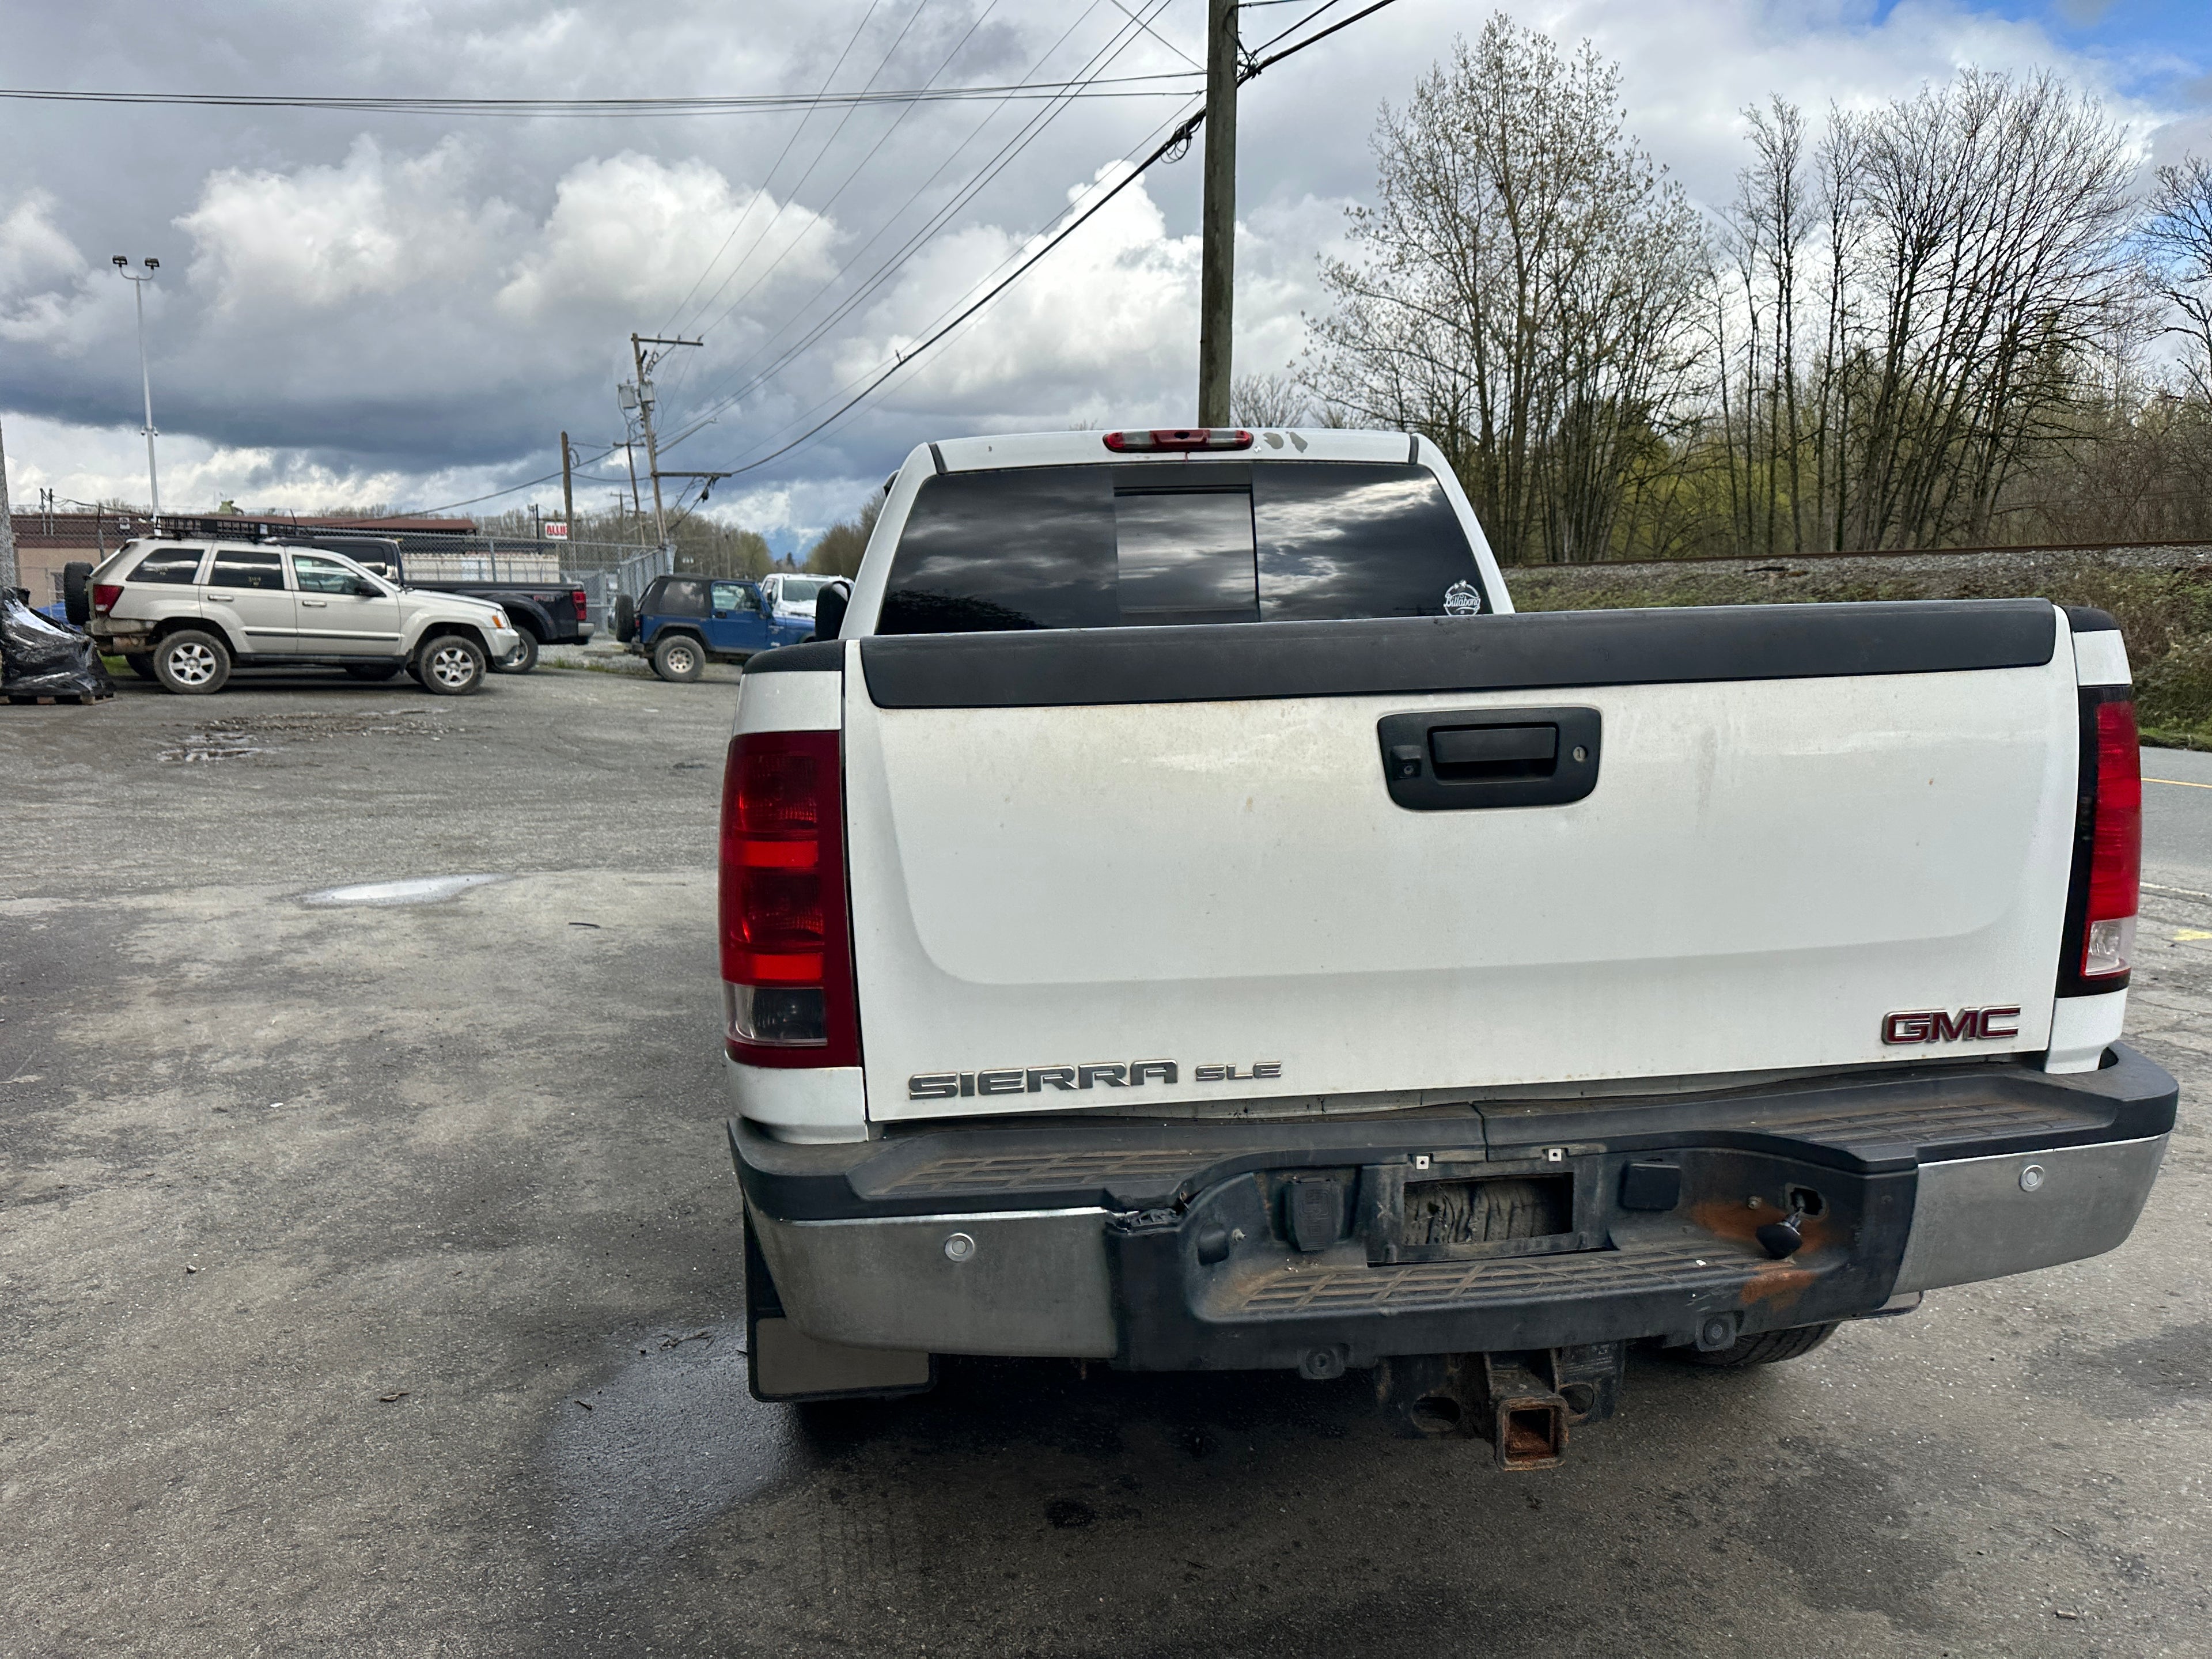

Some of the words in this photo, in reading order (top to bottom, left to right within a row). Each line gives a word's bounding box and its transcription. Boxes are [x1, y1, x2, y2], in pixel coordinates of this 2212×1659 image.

[1444, 594, 1480, 609] Billabong
[1881, 1004, 2021, 1044] GMC
[908, 1059, 1178, 1100] SIERRA
[1195, 1060, 1282, 1081] SLE
